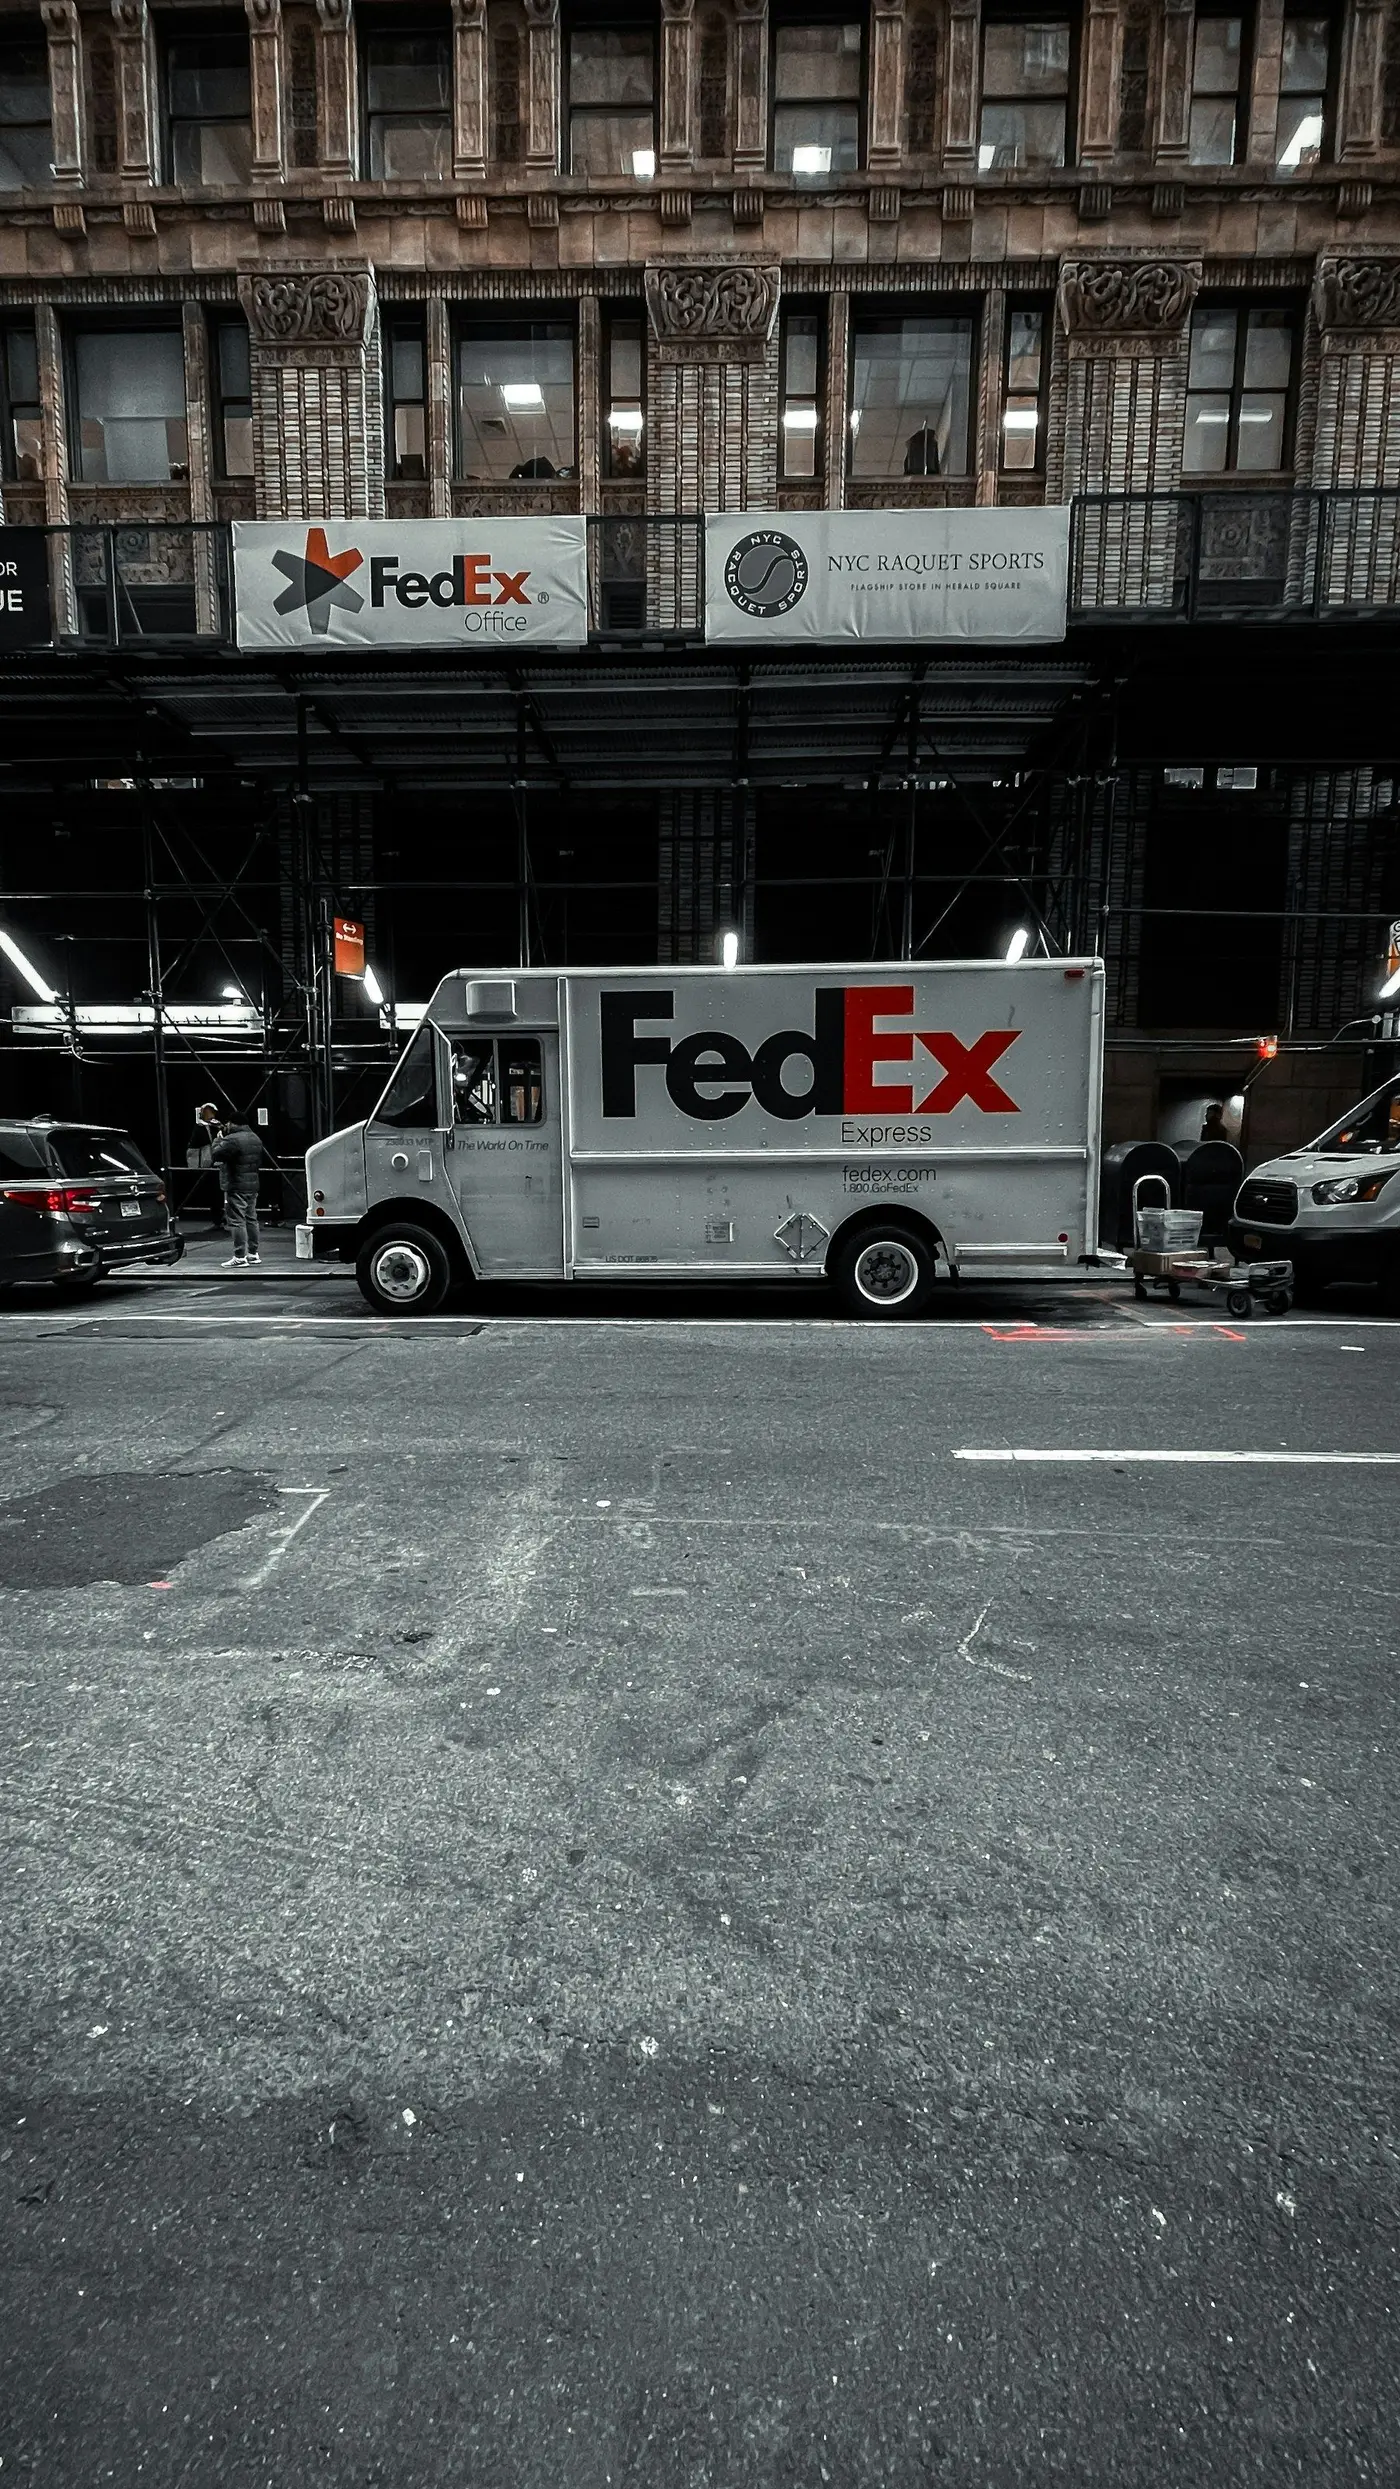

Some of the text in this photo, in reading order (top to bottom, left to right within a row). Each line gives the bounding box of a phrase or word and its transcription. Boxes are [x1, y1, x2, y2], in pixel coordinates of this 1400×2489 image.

[750, 534, 782, 545] NYC
[827, 552, 1045, 575] NYC RAQUET SPORTS
[370, 554, 532, 609] FedEx
[727, 551, 767, 615] RACQUET
[778, 549, 806, 611] SPORTS
[850, 581, 1021, 591] FLAGSHIP STORE IN HERALD SQUARE
[464, 610, 527, 632] Office
[600, 985, 1023, 1121] FedEx
[457, 1140, 550, 1151] The World On Time
[841, 1121, 933, 1147] Express
[841, 1164, 937, 1182] fedex.com
